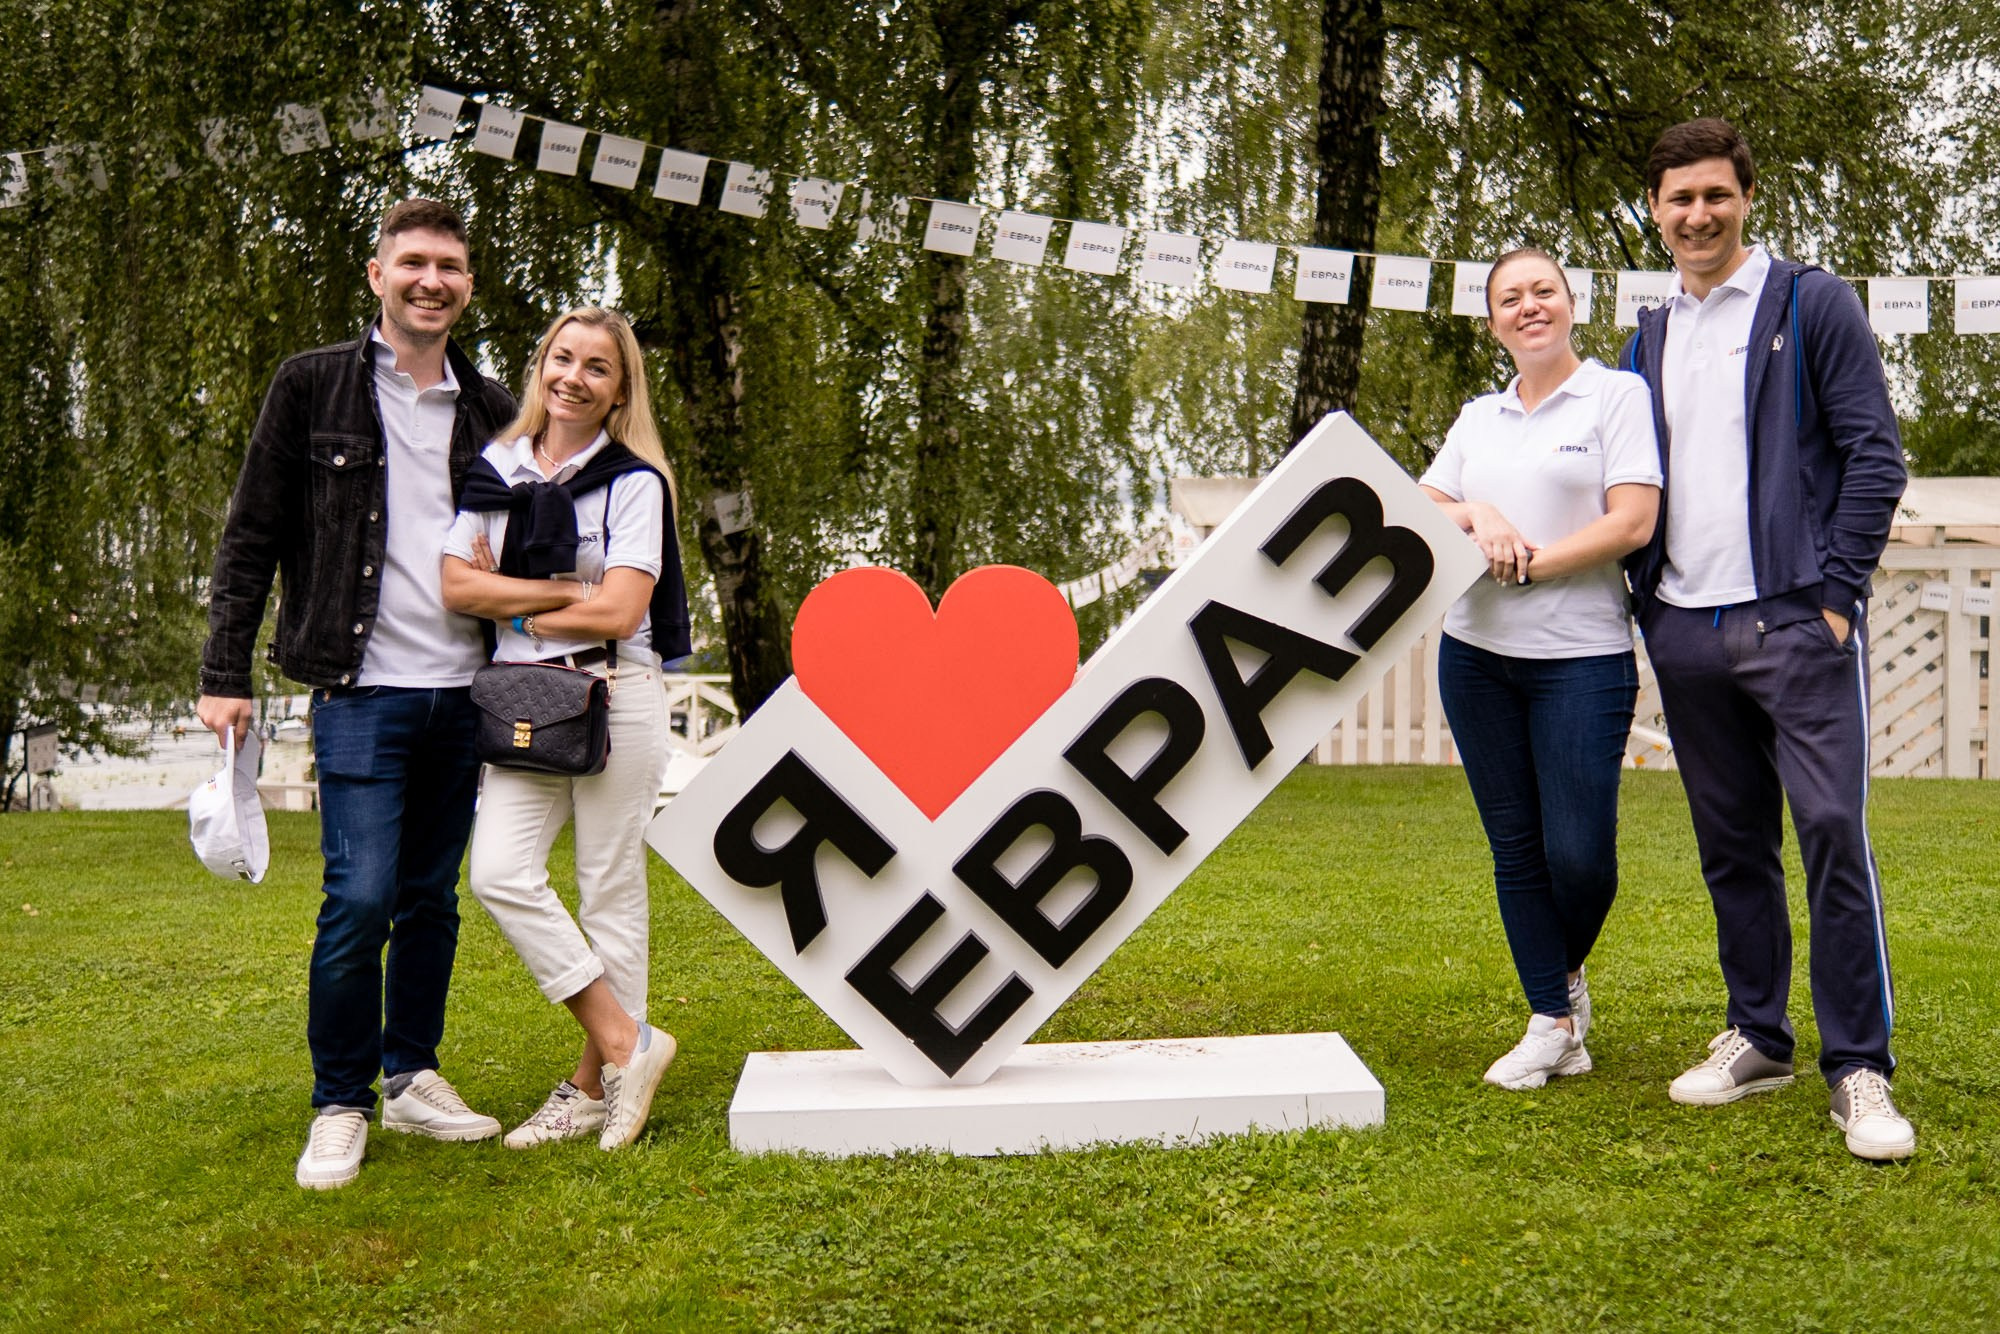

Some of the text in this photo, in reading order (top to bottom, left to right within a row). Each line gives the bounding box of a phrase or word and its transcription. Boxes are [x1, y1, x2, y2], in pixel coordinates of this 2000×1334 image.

[488, 125, 515, 139] ЕВРАЗ
[550, 143, 577, 154] ЕВРАЗ
[608, 156, 637, 168] ЕВРАЗ
[670, 170, 699, 183] ЕВРАЗ
[941, 222, 973, 234] ЕВРАЗ
[1010, 231, 1042, 243] ЕВРАЗ
[1082, 242, 1115, 254] ЕВРАЗ
[1158, 253, 1192, 265] ЕВРАЗ
[1234, 261, 1268, 273] ЕВРАЗ
[1311, 270, 1346, 281] ЕВРАЗ
[1388, 279, 1423, 289] ЕВРАЗ
[1884, 301, 1921, 310] ЕВРАЗ
[1971, 300, 2000, 309] ЕВРА
[1559, 445, 1588, 453] ЕВРАЗ
[577, 535, 598, 544] ВРАЗ
[844, 476, 1434, 1078] ЕВРАЗ
[713, 748, 897, 955] Я
